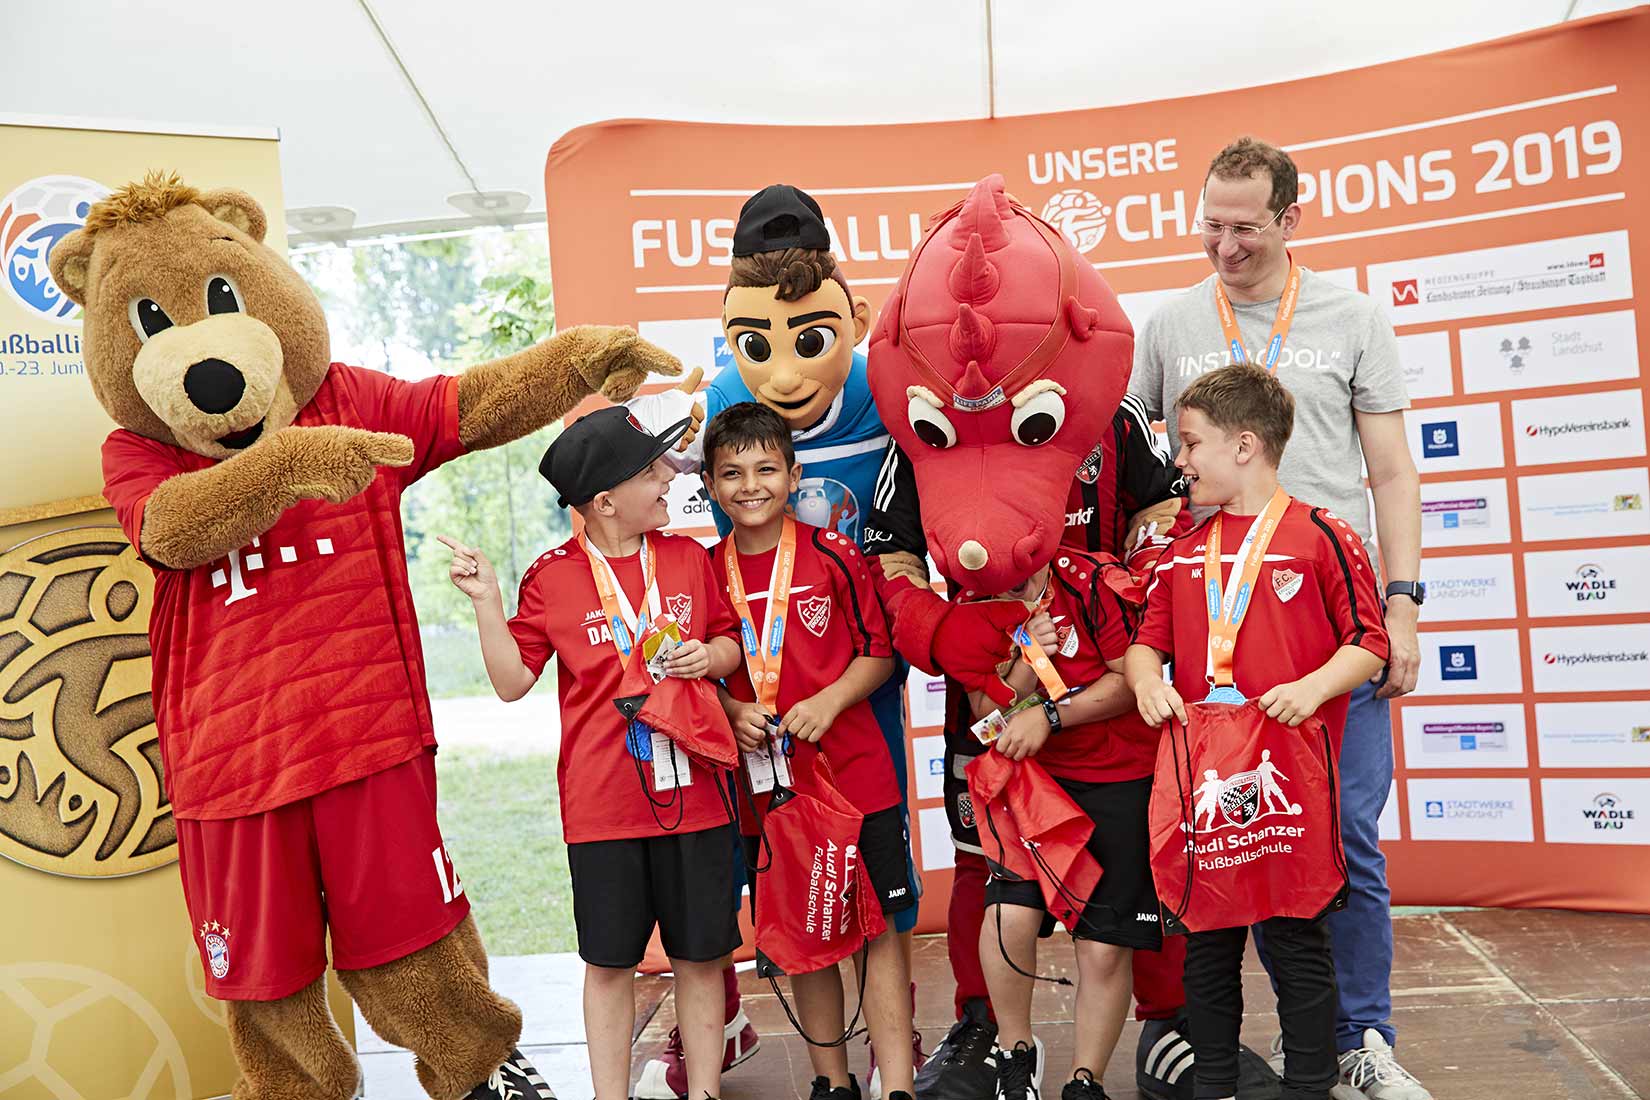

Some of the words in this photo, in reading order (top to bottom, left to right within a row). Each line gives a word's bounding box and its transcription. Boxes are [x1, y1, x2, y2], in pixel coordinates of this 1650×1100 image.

[1028, 138, 1179, 185] UNSERE
[632, 213, 922, 268] FUSALLI
[1115, 150, 1456, 242] CHPIONS
[1471, 119, 1622, 194] 2019
[0, 334, 80, 354] ußballi
[51, 361, 83, 375] Juni
[1539, 417, 1631, 437] HypoVereinsbank
[1065, 506, 1093, 526] arkt
[1191, 568, 1203, 579] NK
[1429, 577, 1497, 589] STADTWERKE
[1565, 579, 1617, 591] WADLE
[1430, 587, 1487, 599] LANDSHUT
[1576, 591, 1606, 602] BAU
[1557, 650, 1648, 666] HypoVereinsbank
[1446, 800, 1514, 810] STADTWERKE
[1447, 809, 1504, 819] LANDSHUT
[1583, 809, 1634, 820] WADLE
[1593, 820, 1624, 830] BAU
[1226, 826, 1305, 849] Schanzer
[826, 839, 838, 880] Audi
[1198, 841, 1293, 870] Fußballschule
[806, 845, 823, 934] Fußballschule
[888, 887, 906, 899] JAKO
[821, 879, 837, 941] Schanzer
[1136, 912, 1158, 922] JAKO
